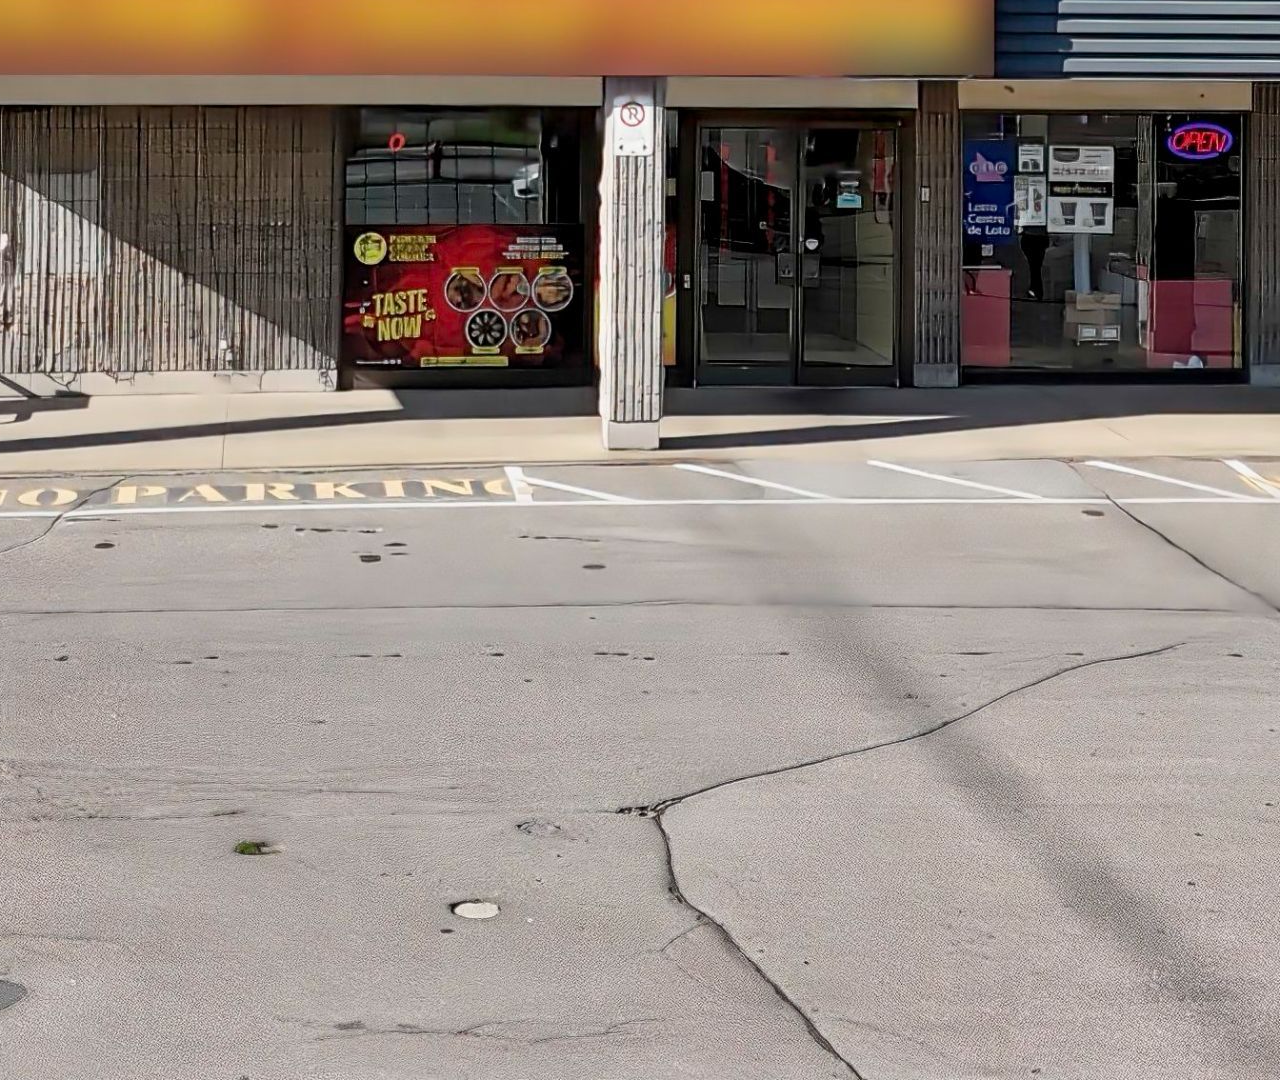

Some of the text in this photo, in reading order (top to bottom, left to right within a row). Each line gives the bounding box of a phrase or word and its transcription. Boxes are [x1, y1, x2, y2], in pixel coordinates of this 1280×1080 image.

[1173, 131, 1226, 152] OPEN
[372, 289, 428, 317] TASTE
[378, 314, 422, 341] NOW
